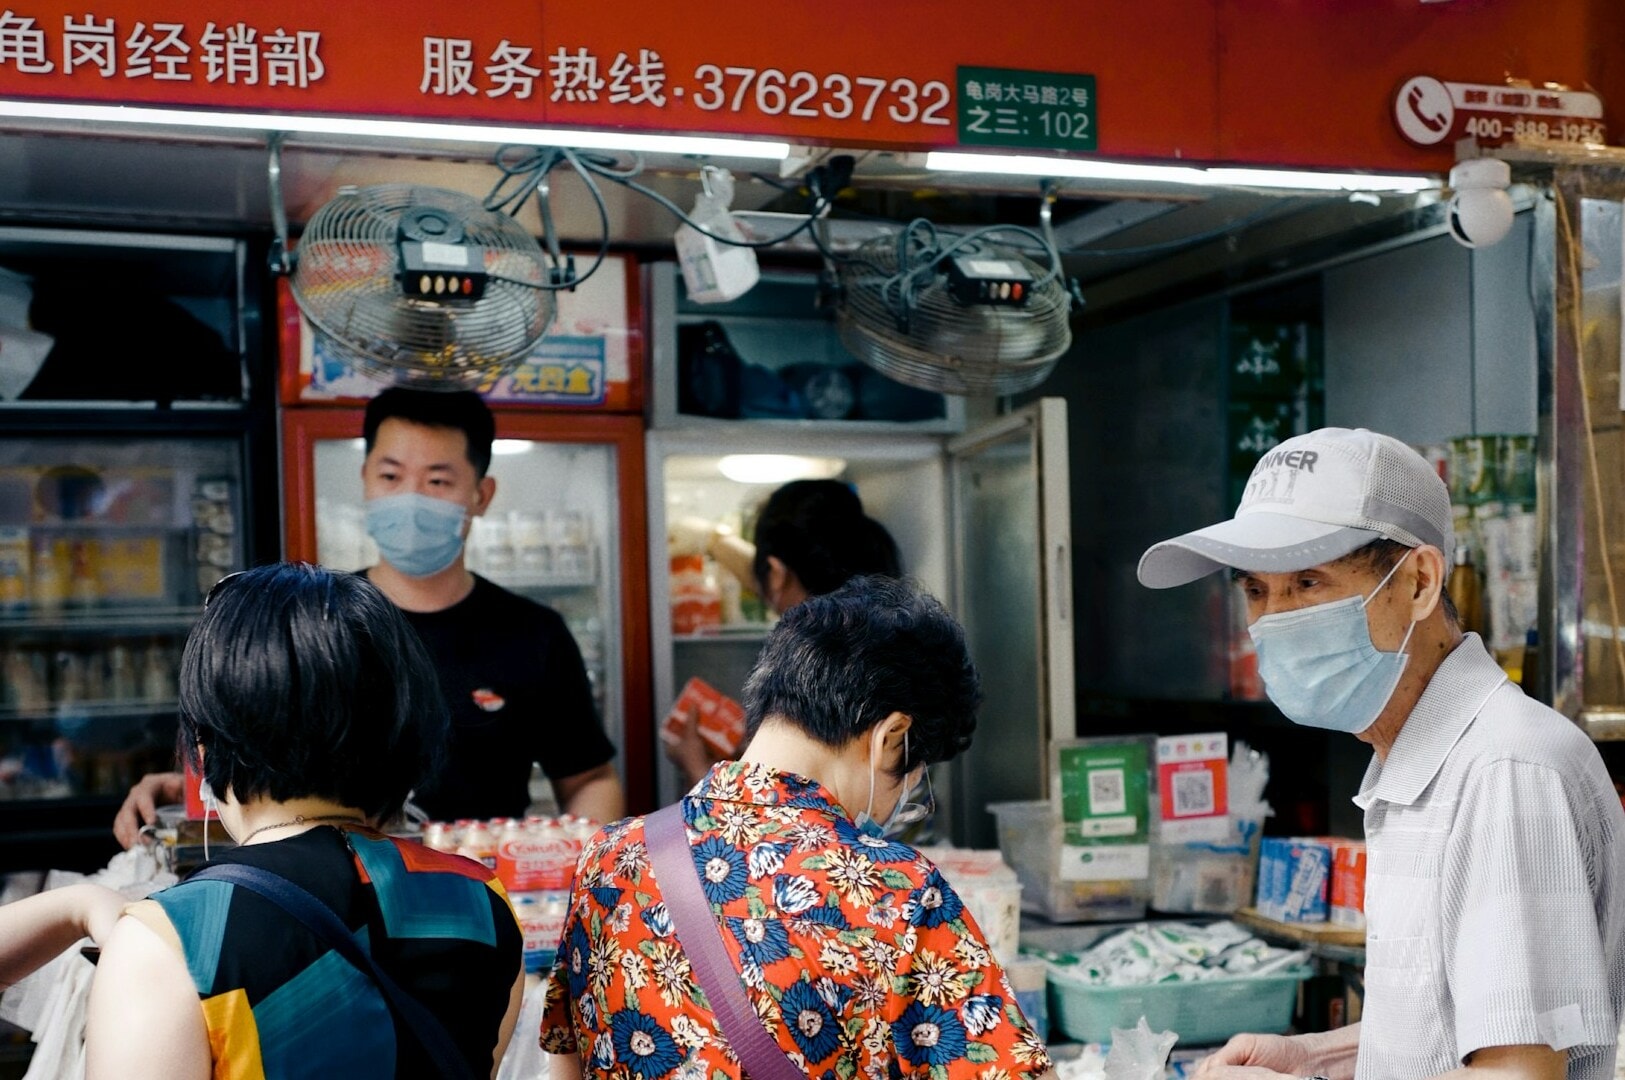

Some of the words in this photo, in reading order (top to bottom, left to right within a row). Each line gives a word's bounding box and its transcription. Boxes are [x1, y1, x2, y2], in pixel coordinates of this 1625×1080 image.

[0, 10, 326, 88] 龟岗经销部
[965, 80, 1089, 107] 龟岗大马路2号
